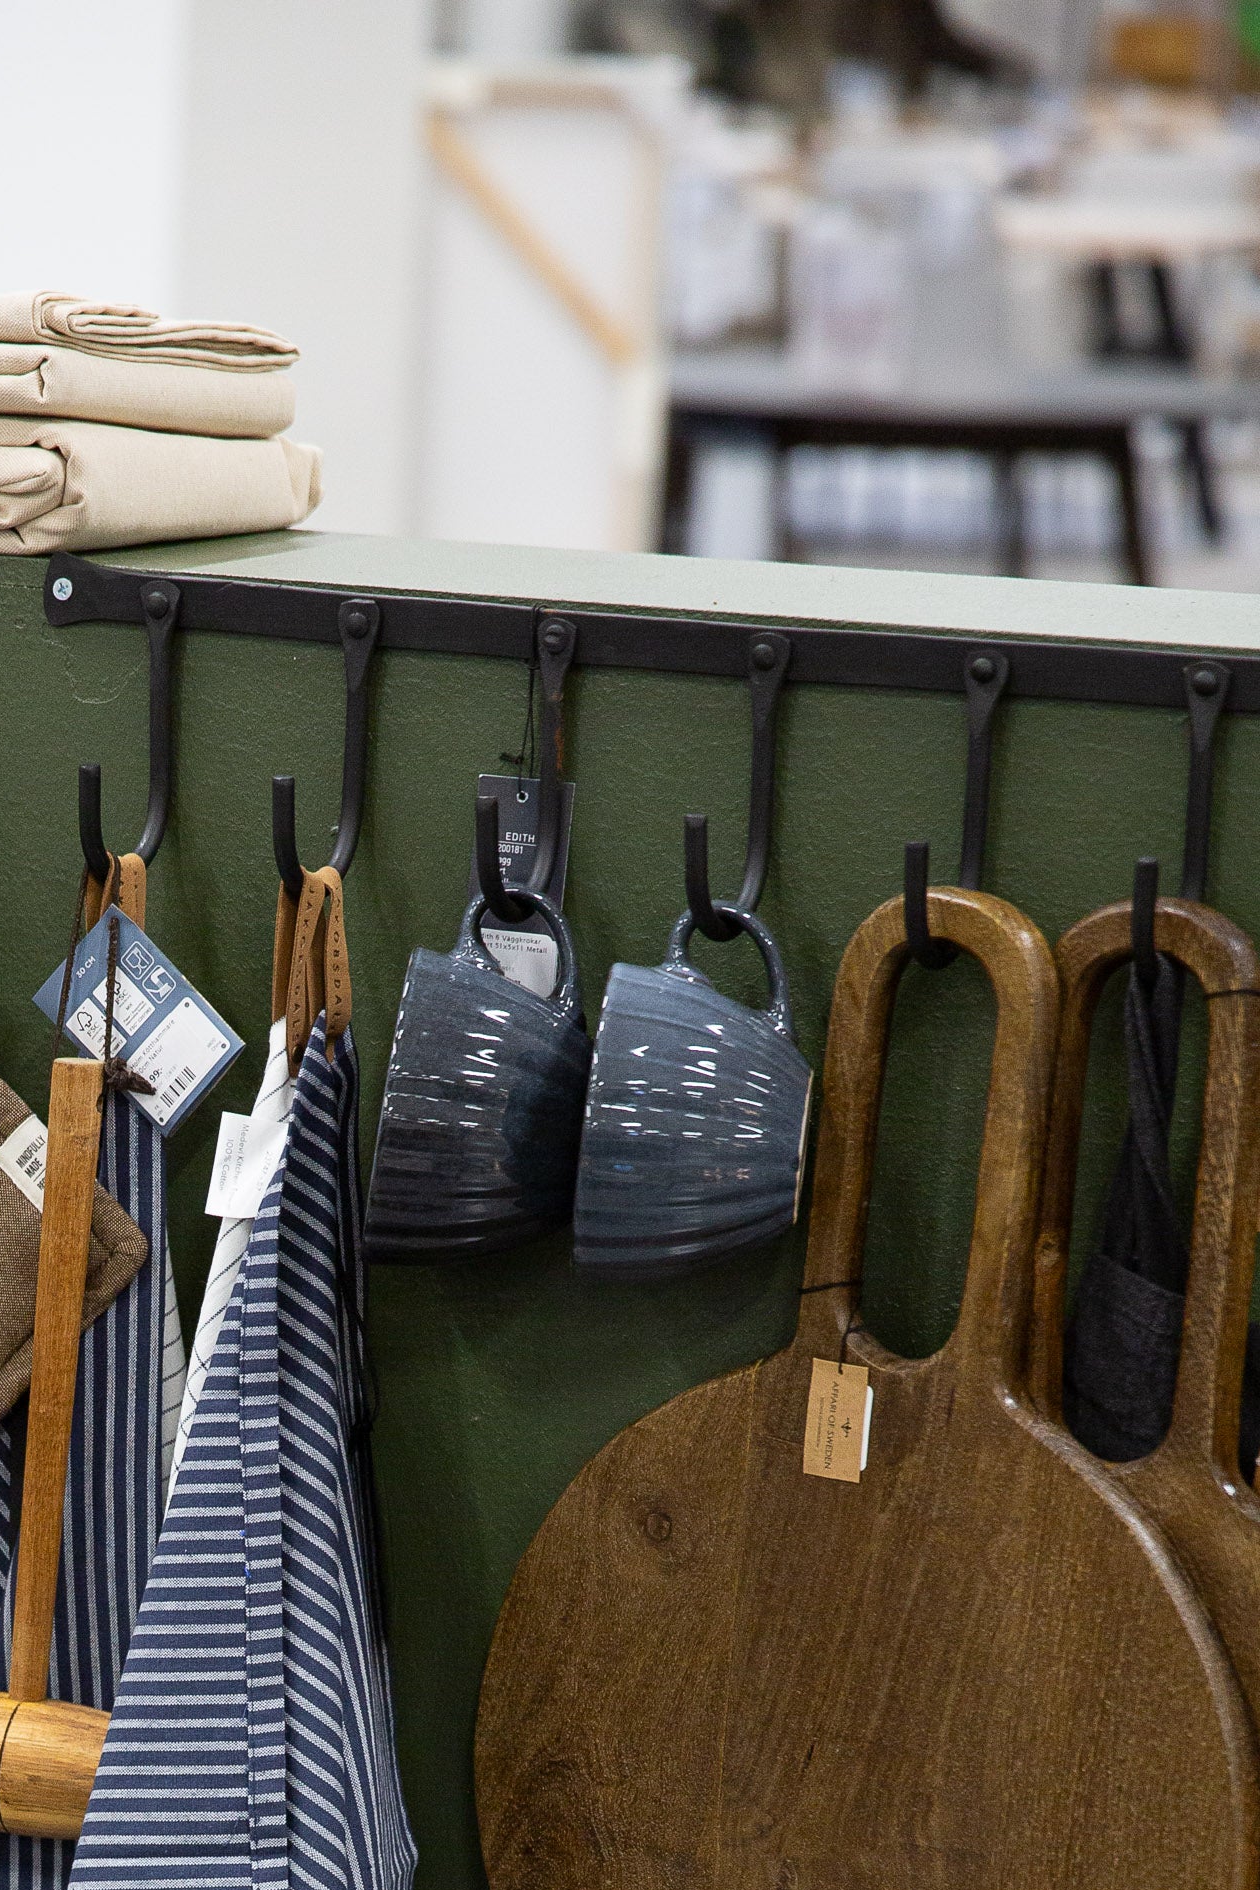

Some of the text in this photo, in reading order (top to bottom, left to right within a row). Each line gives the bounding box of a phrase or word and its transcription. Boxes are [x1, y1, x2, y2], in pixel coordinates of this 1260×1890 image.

[505, 832, 535, 843] EDITH
[75, 956, 97, 979] 30 CM
[15, 1134, 46, 1169] MINDFULLY
[218, 1138, 234, 1191] 100% Cotton
[24, 1157, 43, 1179] MADE
[824, 1431, 834, 1469] SWEDEN
